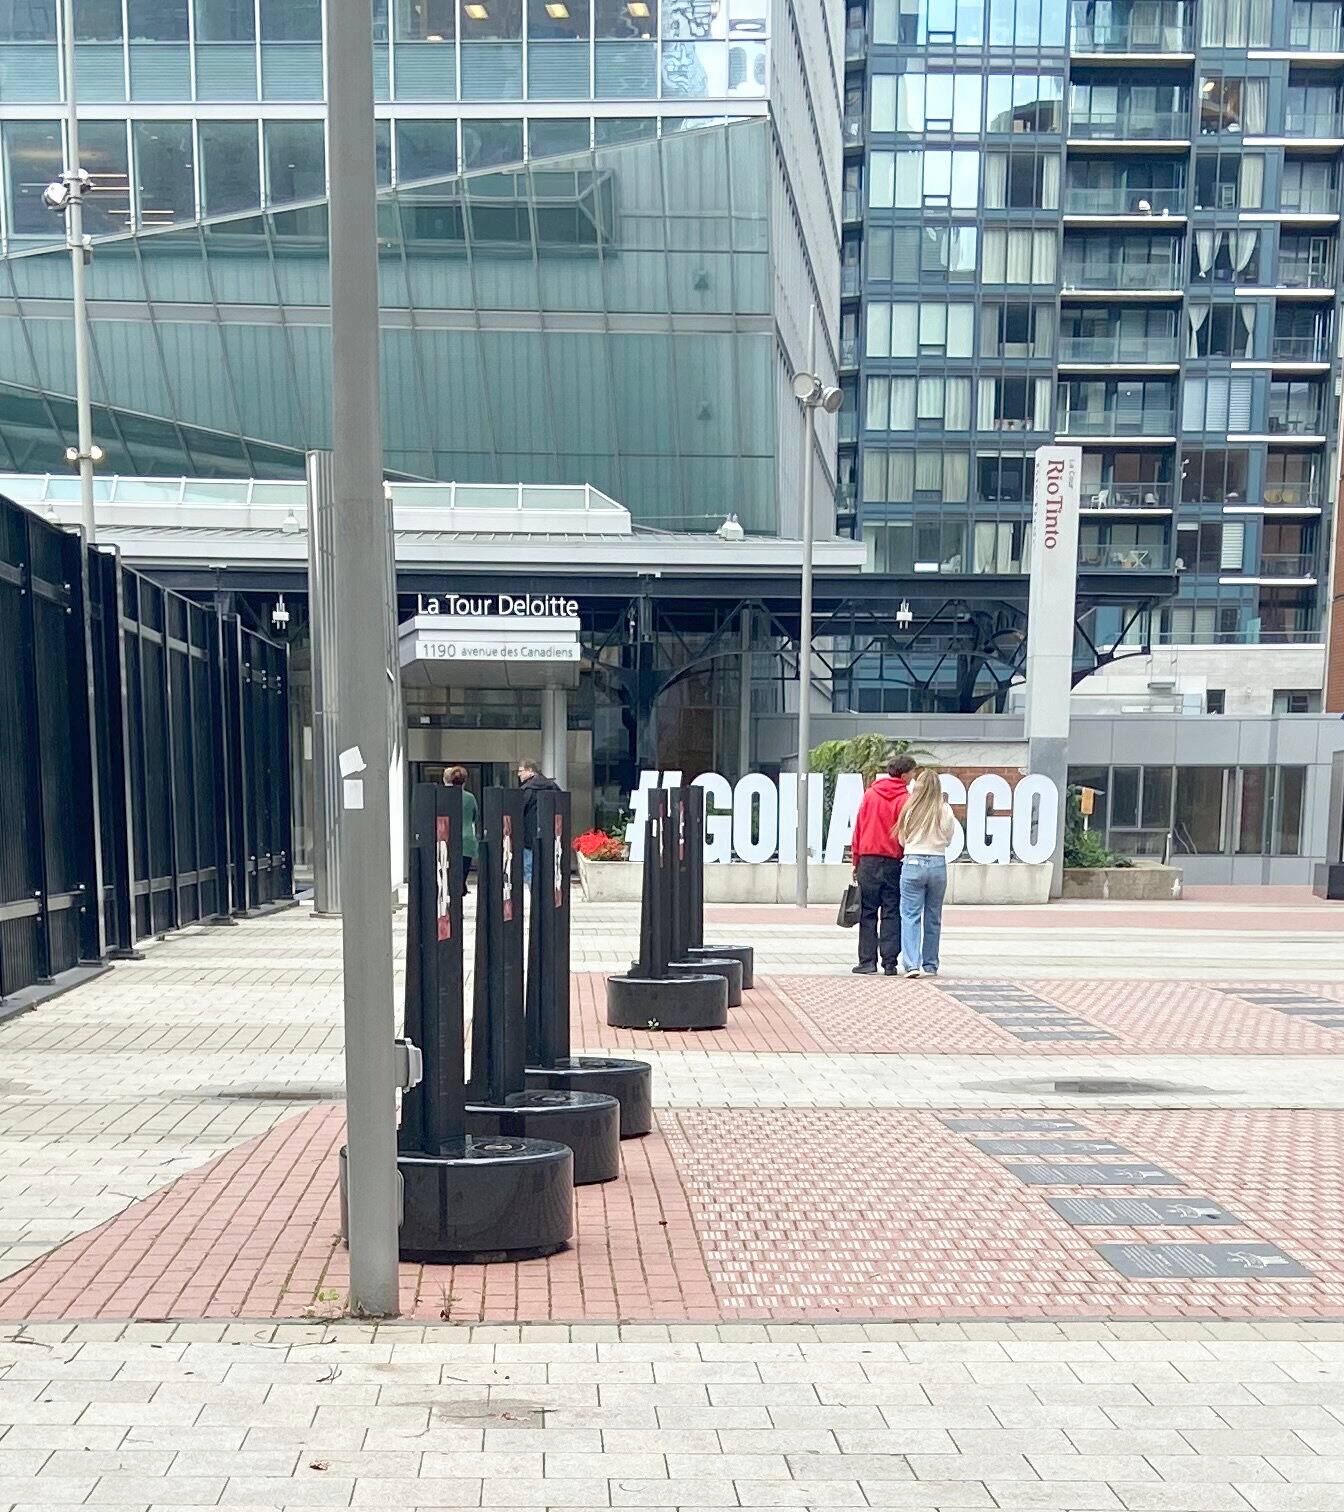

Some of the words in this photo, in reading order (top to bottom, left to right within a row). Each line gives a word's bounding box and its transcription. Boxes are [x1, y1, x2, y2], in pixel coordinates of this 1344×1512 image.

[418, 594, 439, 615] La
[446, 595, 492, 615] Tour
[498, 594, 578, 616] Deloitte
[423, 644, 456, 658] 1190
[461, 646, 498, 657] avenue
[500, 646, 518, 658] des
[520, 646, 573, 658] Canadiens
